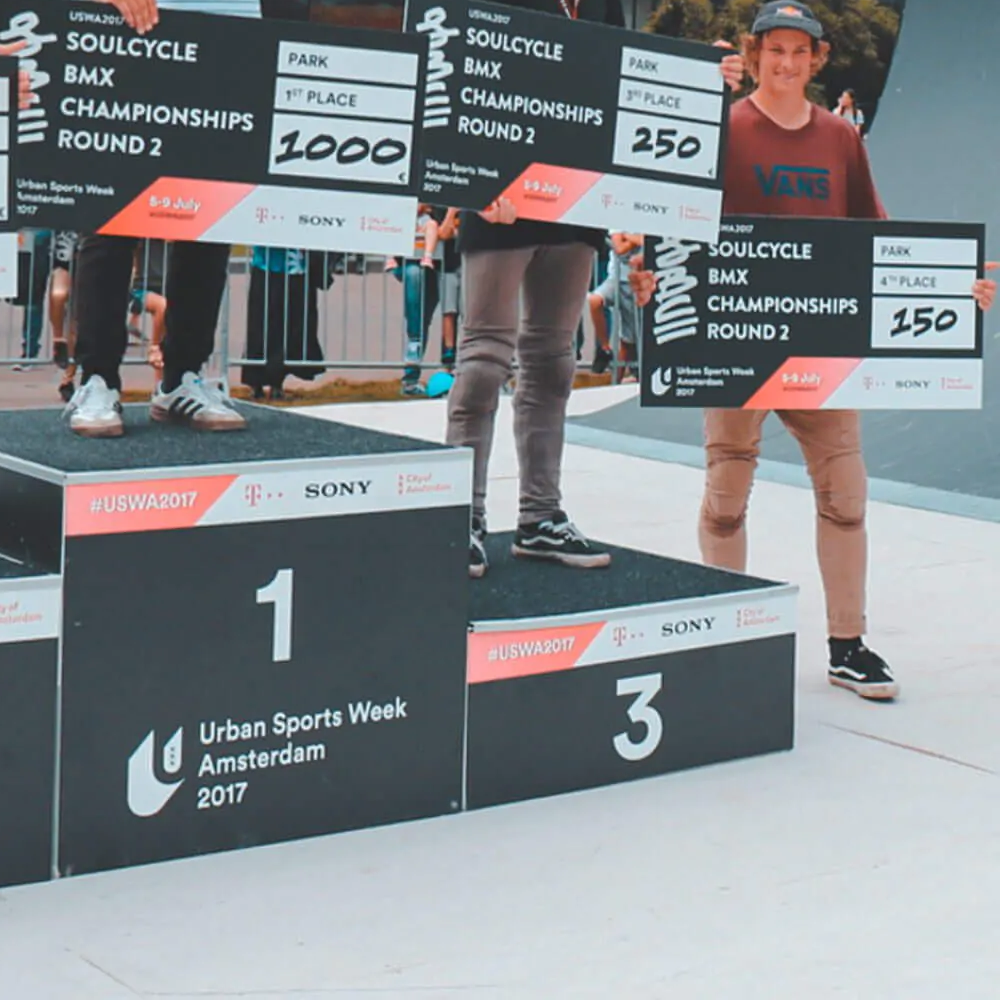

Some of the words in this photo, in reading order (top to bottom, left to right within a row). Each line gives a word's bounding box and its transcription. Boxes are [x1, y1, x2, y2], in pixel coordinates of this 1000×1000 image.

[69, 10, 125, 26] USWA2017
[468, 8, 511, 25] USWA2017
[66, 32, 199, 62] SOULCYCLE
[466, 27, 564, 62] SOULCYCLE
[288, 52, 329, 69] PARK
[464, 56, 502, 80] BMX
[628, 56, 659, 73] PARK
[64, 64, 115, 87] BMX
[307, 90, 358, 108] PLACE
[460, 86, 604, 126] CHAMPIONSHIPS
[643, 91, 682, 110] PLACE
[60, 97, 254, 132] CHAMPIONSHIPS
[458, 115, 522, 143] ROUND
[525, 127, 536, 145] 2
[58, 129, 145, 155] ROUND
[149, 137, 163, 156] 2
[275, 130, 407, 165] 1000
[632, 126, 701, 159] 250
[16, 178, 47, 190] Urban
[50, 181, 83, 194] Sports
[85, 184, 115, 196] Week
[753, 163, 831, 200] VANS
[173, 196, 202, 213] July
[633, 202, 670, 214] SONY
[299, 215, 345, 227] SONY
[708, 241, 812, 260] SOULCYCLE
[880, 245, 911, 257] PARK
[708, 268, 749, 286] BMX
[899, 276, 937, 288] PLACE
[707, 296, 859, 315] CHAMPIONSHIPS
[707, 323, 778, 342] ROUND
[780, 323, 790, 342] 2
[889, 306, 958, 338] 150
[895, 379, 931, 390] SONY
[304, 480, 372, 499] SONY
[90, 491, 198, 514] #USWA2017
[255, 568, 294, 662] 1
[661, 617, 716, 638] SONY
[488, 636, 576, 662] #USWA2017
[200, 721, 267, 745] Urban
[272, 708, 343, 738] Sports
[348, 697, 408, 724] Week
[613, 672, 663, 761] 3
[197, 741, 326, 777] Amsterdam
[197, 782, 249, 809] 2017
